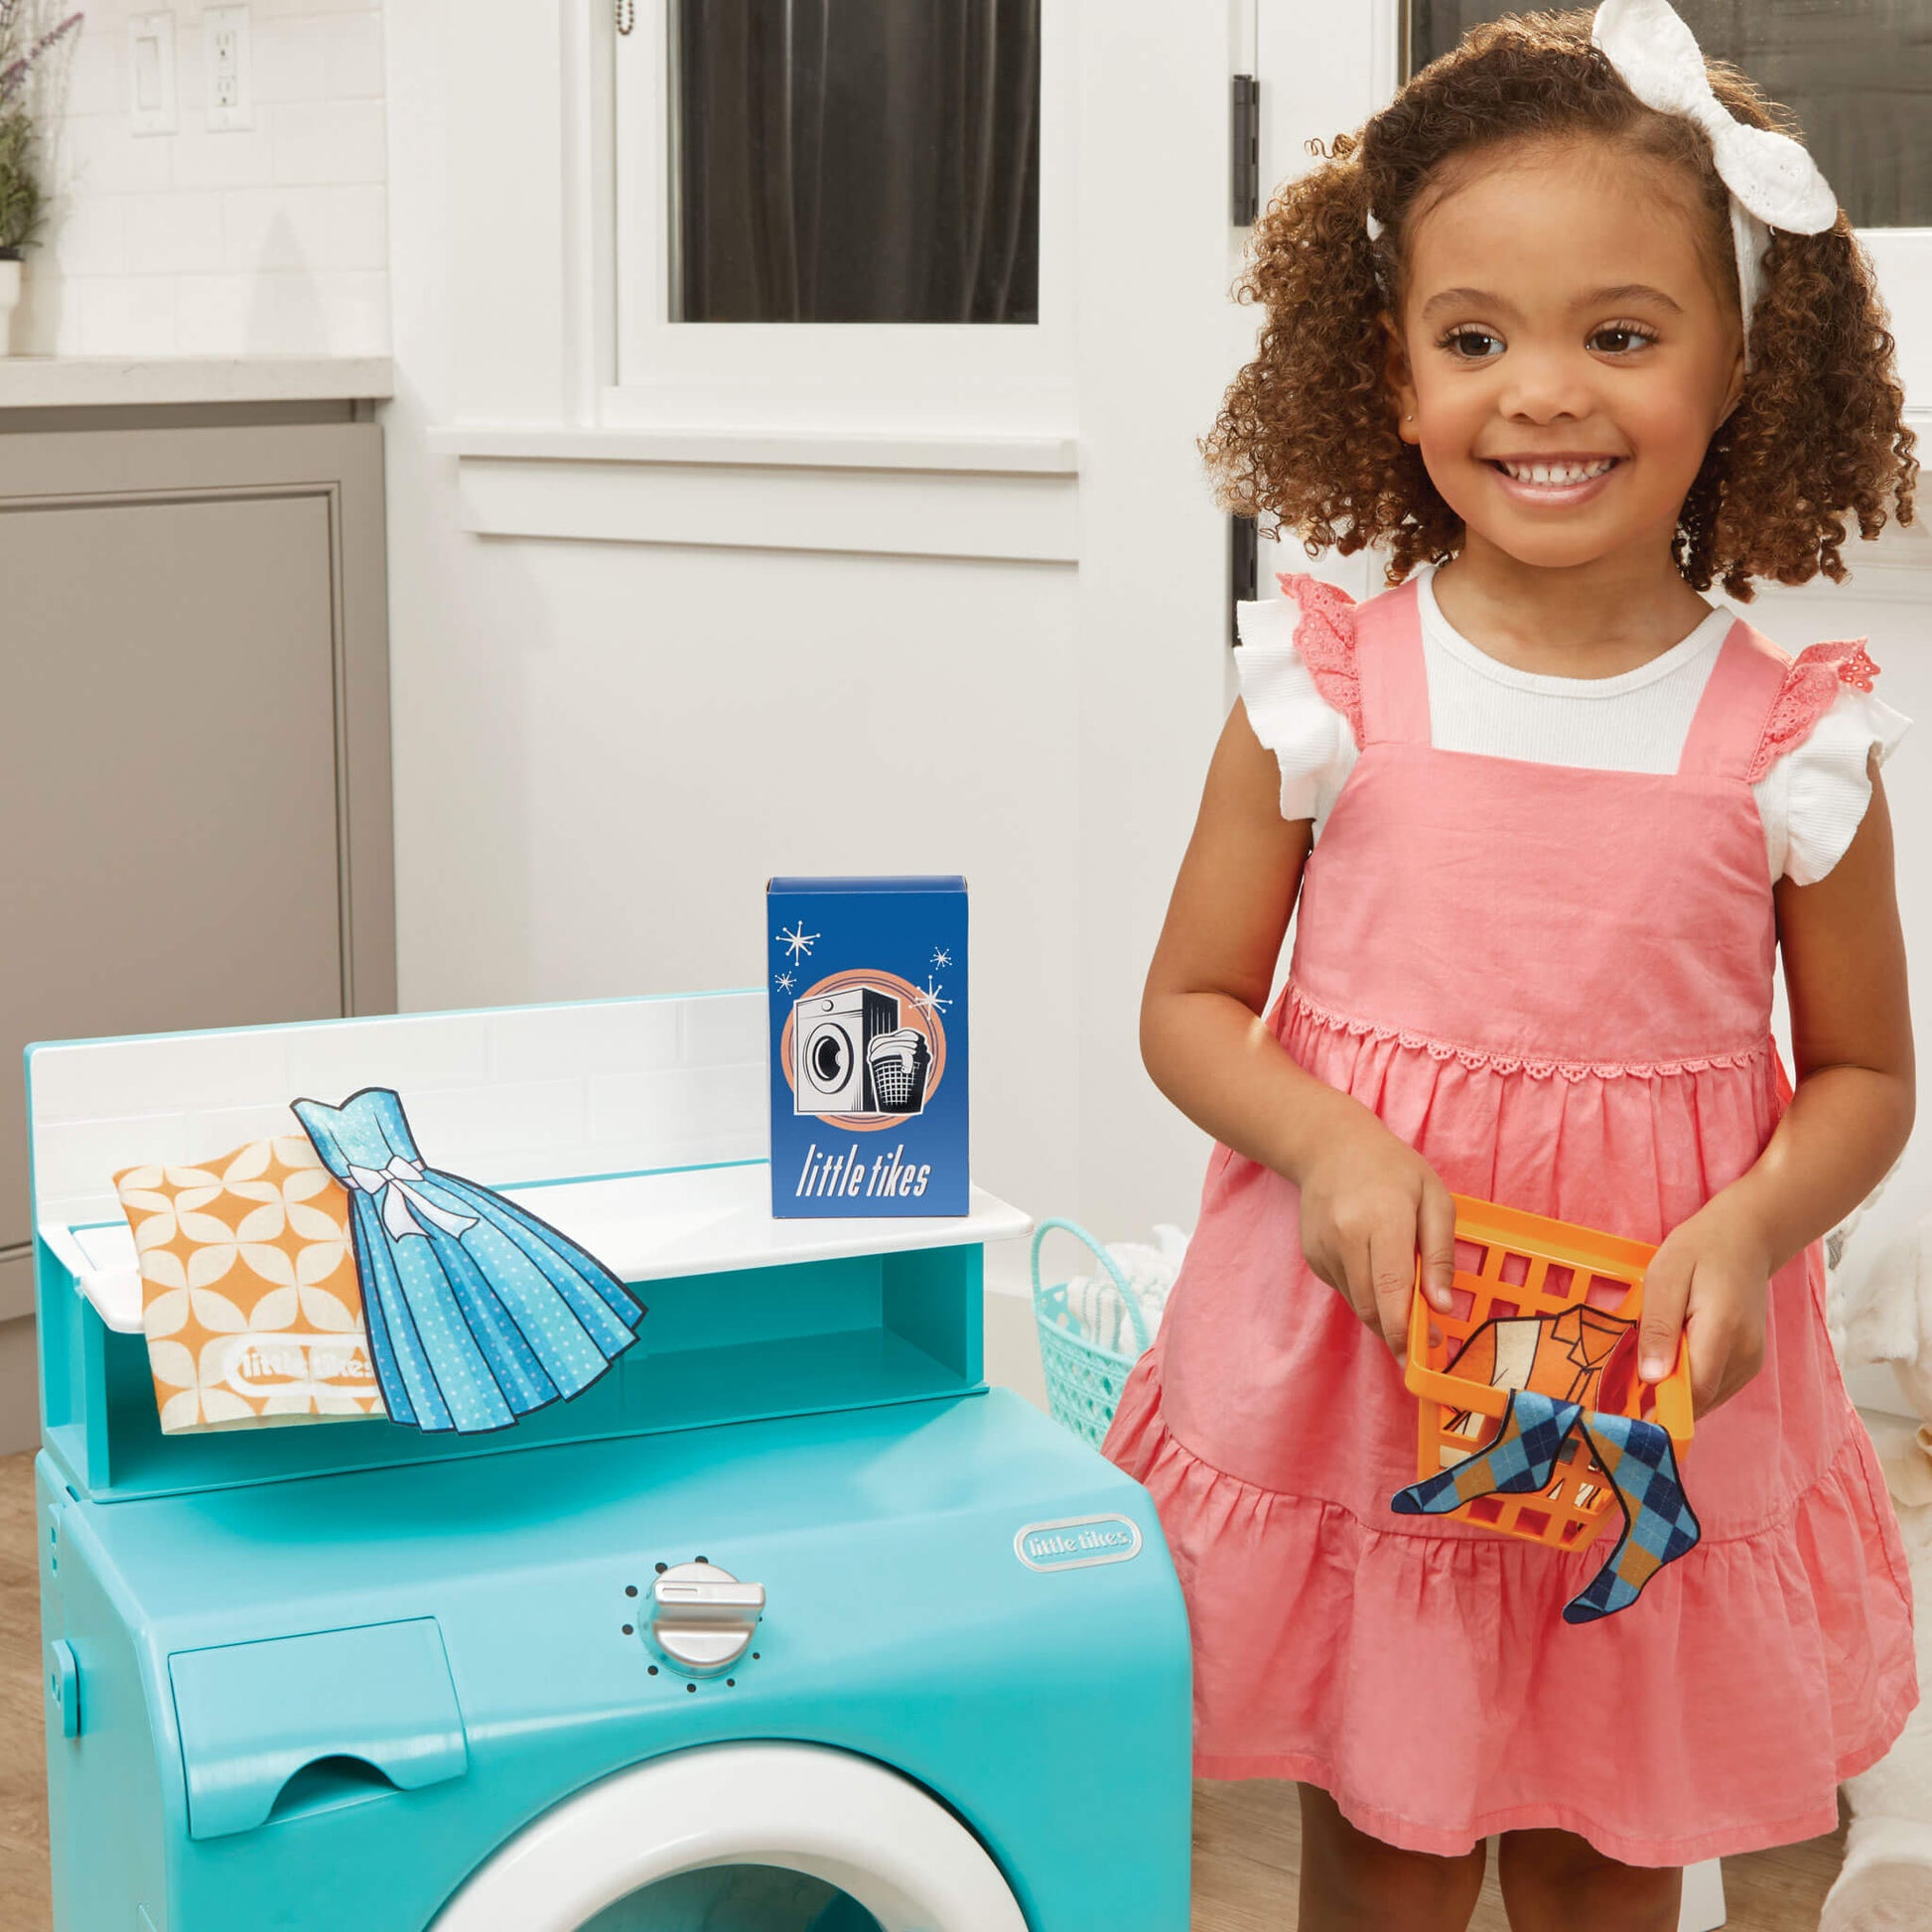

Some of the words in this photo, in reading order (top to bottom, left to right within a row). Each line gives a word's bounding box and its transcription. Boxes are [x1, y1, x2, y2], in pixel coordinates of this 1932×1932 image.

[795, 1144, 866, 1197] little
[866, 1144, 931, 1197] tikes
[241, 1350, 306, 1377] little
[1029, 1535, 1077, 1557] little
[1078, 1530, 1130, 1550] tikes
